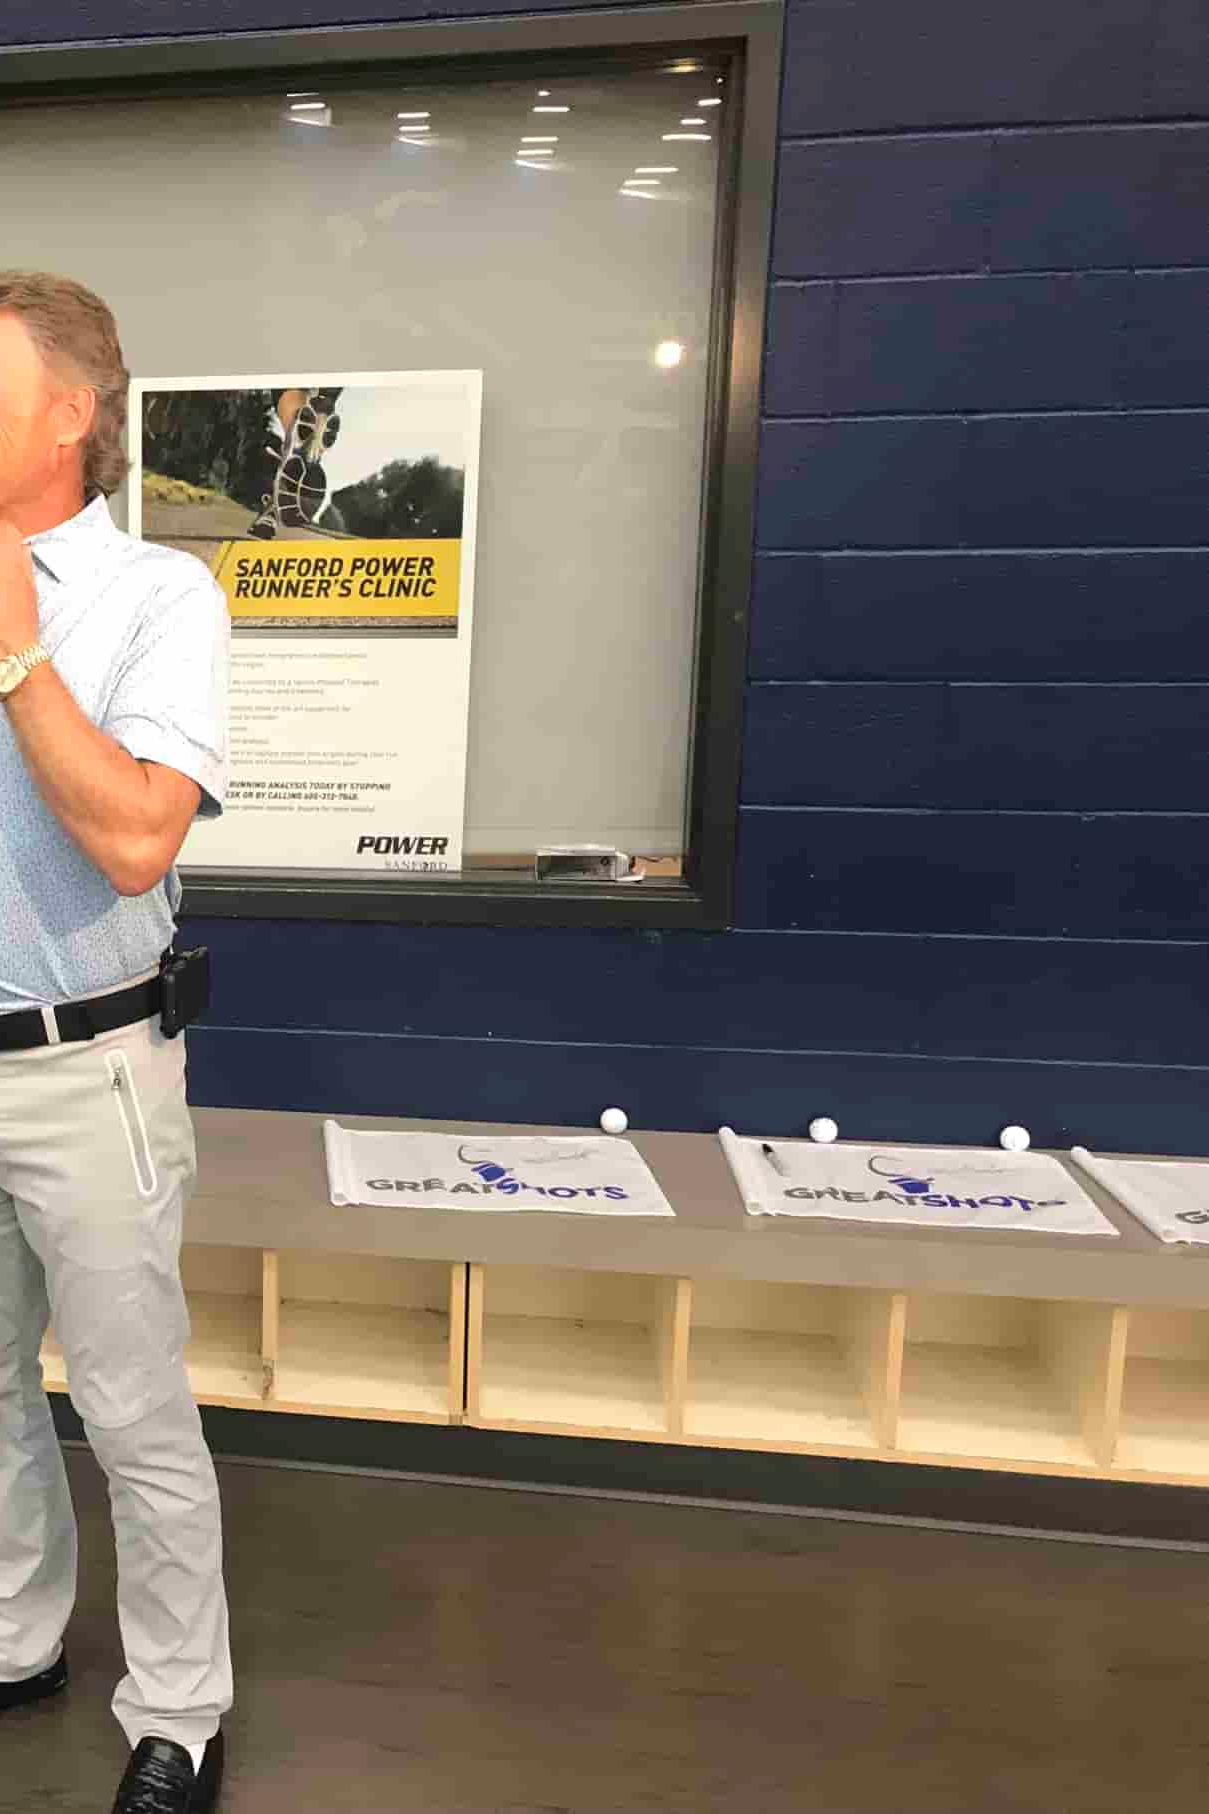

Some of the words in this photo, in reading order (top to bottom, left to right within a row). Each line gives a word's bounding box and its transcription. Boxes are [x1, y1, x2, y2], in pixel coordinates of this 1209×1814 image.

[235, 558, 343, 577] SANFORD
[350, 557, 434, 576] POWER
[235, 579, 352, 598] RUNNER'S
[359, 578, 436, 597] CLINIC
[268, 781, 307, 790] ANALYSIS
[309, 782, 335, 790] TODAY
[337, 782, 348, 791] BY
[350, 783, 391, 791] STOPPING
[255, 792, 266, 800] BY
[268, 792, 302, 800] CALLING
[356, 836, 448, 855] POWER
